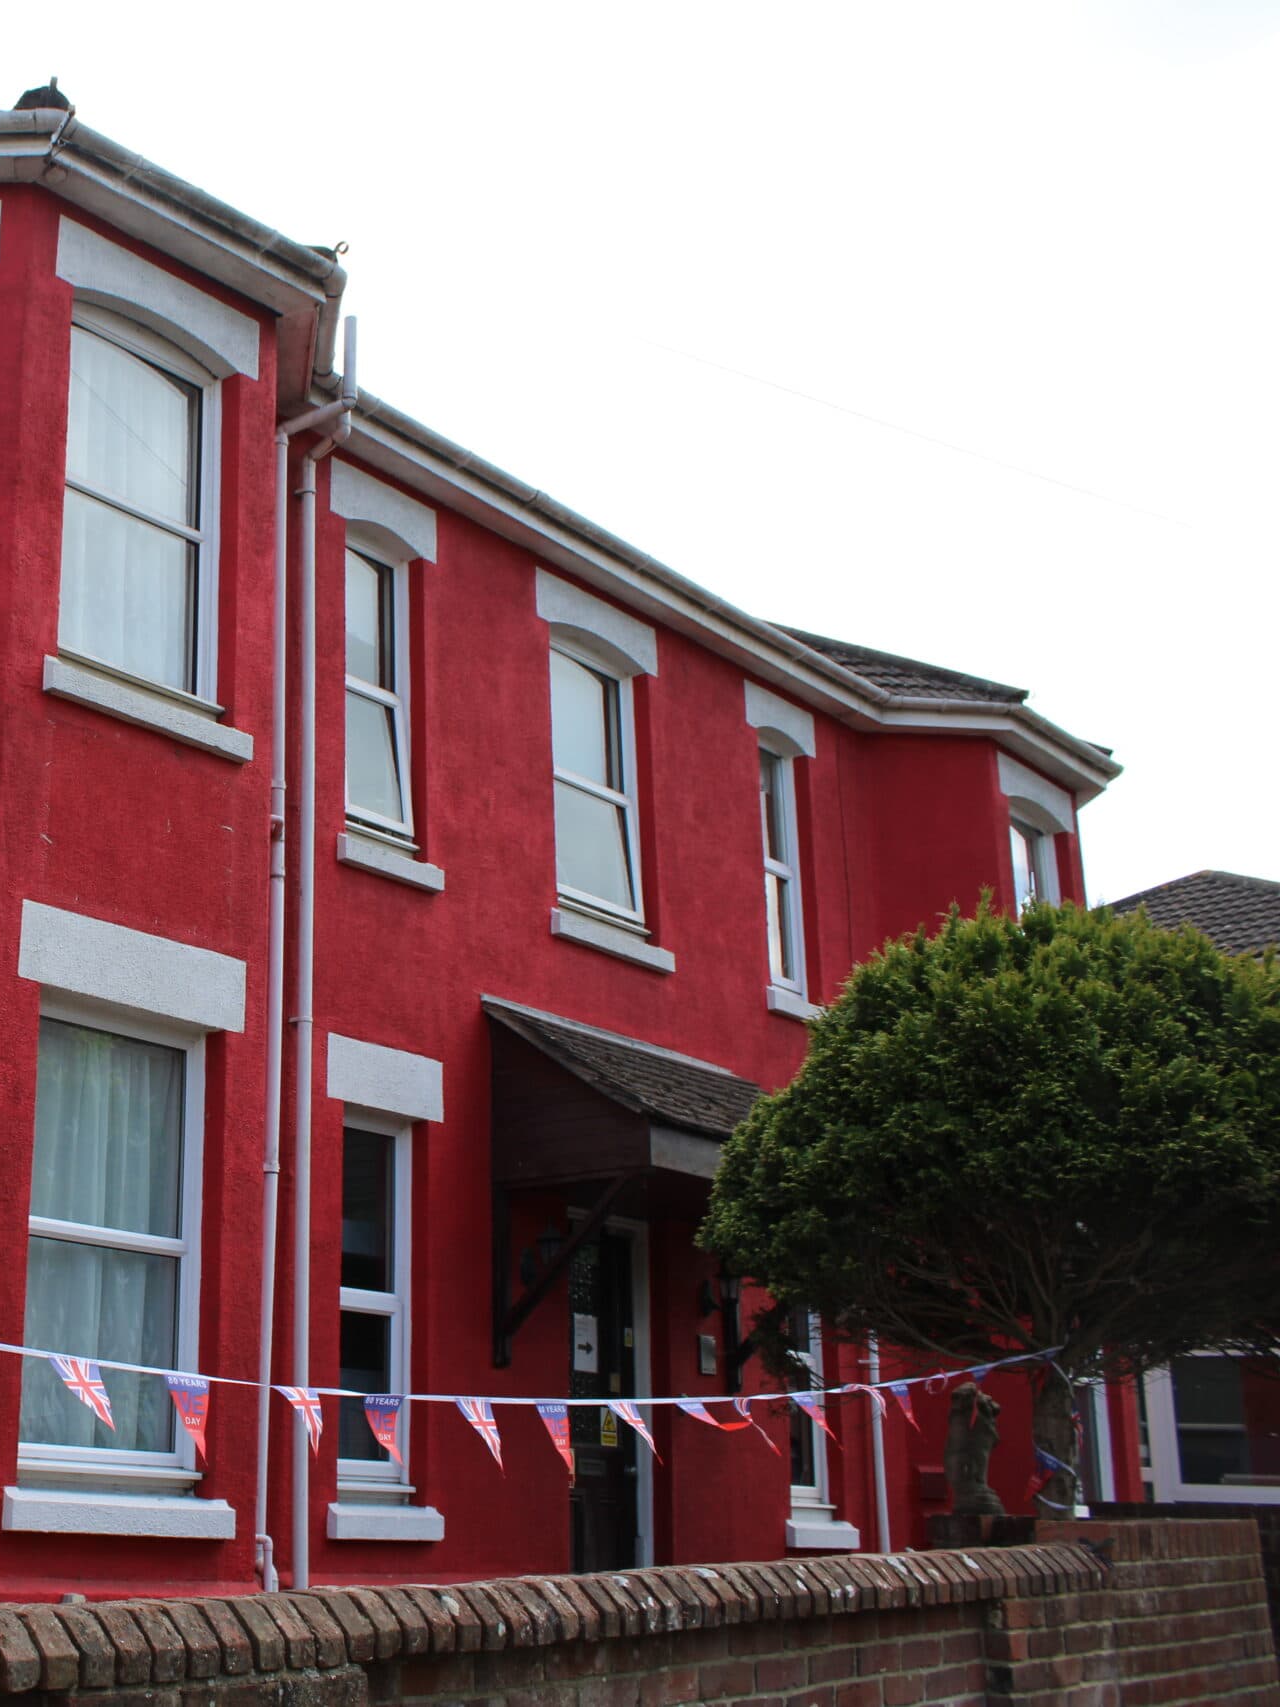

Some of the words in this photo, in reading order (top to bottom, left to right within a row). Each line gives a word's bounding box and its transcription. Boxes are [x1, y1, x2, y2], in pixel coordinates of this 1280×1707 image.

[179, 1377, 207, 1389] YEARS
[177, 1391, 206, 1416] VE
[375, 1397, 400, 1406] YEARS
[184, 1416, 201, 1426] DAY
